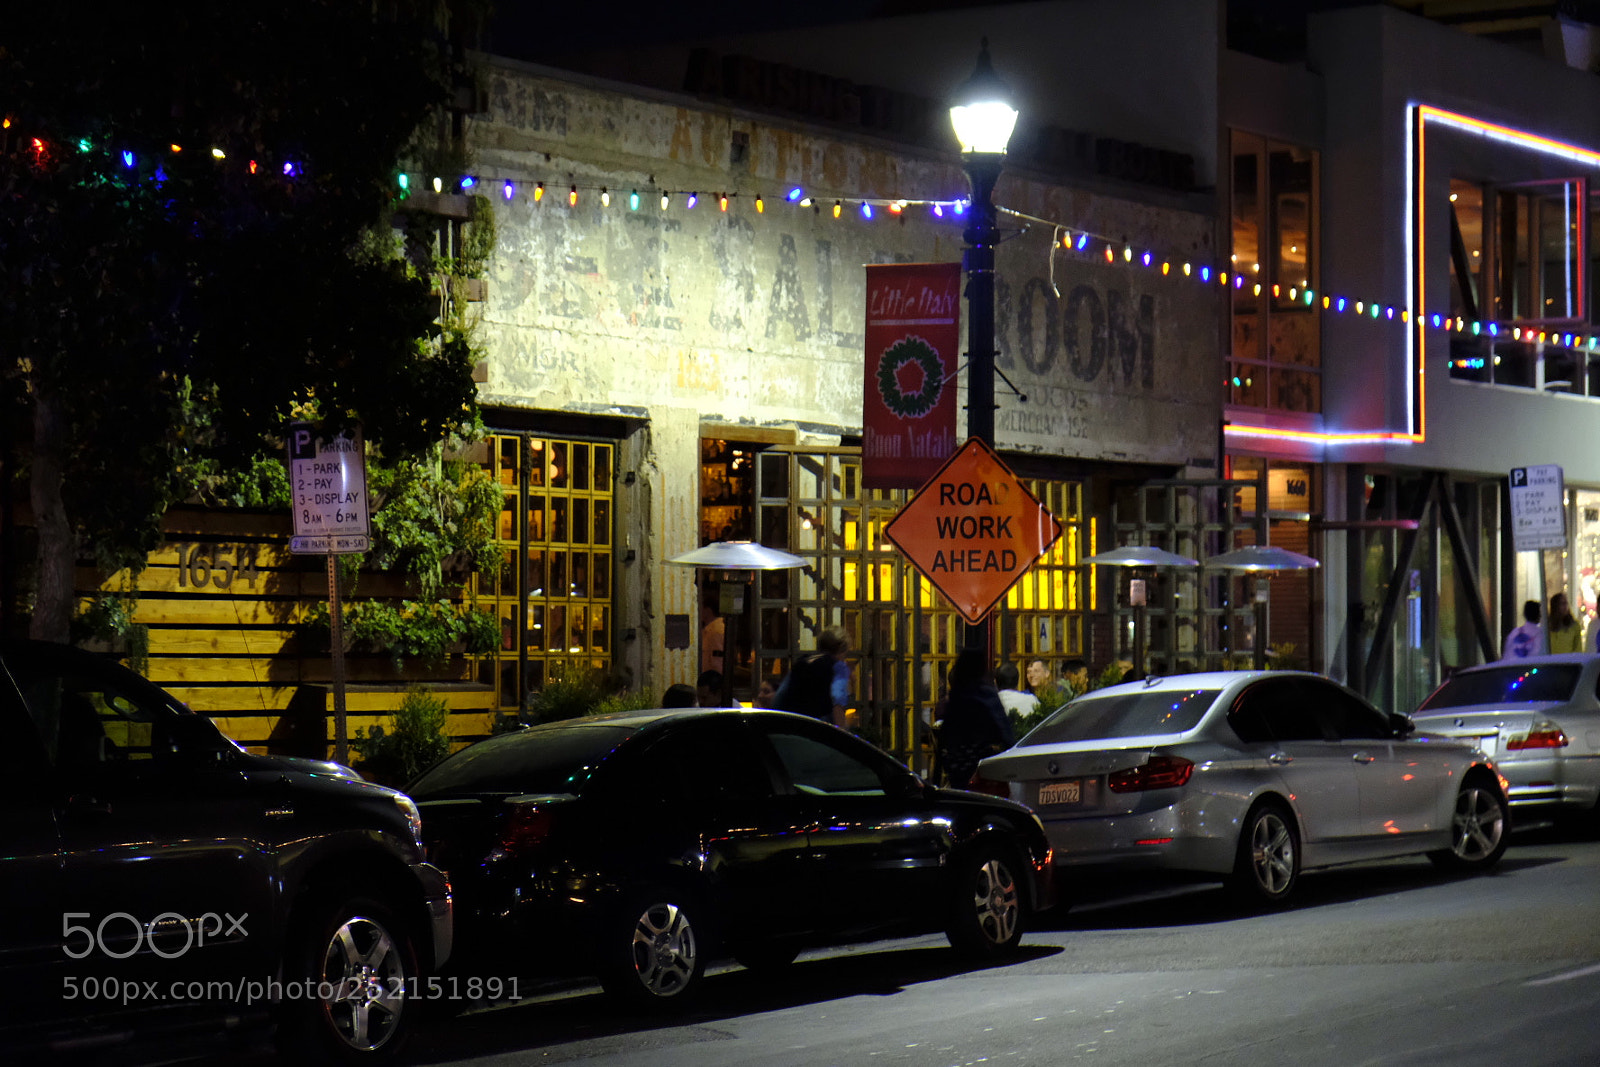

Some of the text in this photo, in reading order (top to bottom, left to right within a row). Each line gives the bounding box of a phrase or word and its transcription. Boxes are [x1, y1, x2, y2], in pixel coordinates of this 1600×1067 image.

[870, 277, 958, 316] Little Italy
[295, 430, 311, 454] P
[314, 463, 341, 474] PARK
[1513, 469, 1524, 485] P
[314, 478, 333, 489] PAY
[315, 492, 359, 505] DISPLAY
[937, 516, 1013, 539] WORK
[175, 542, 258, 589] 1654
[931, 550, 1017, 572] AHEAD
